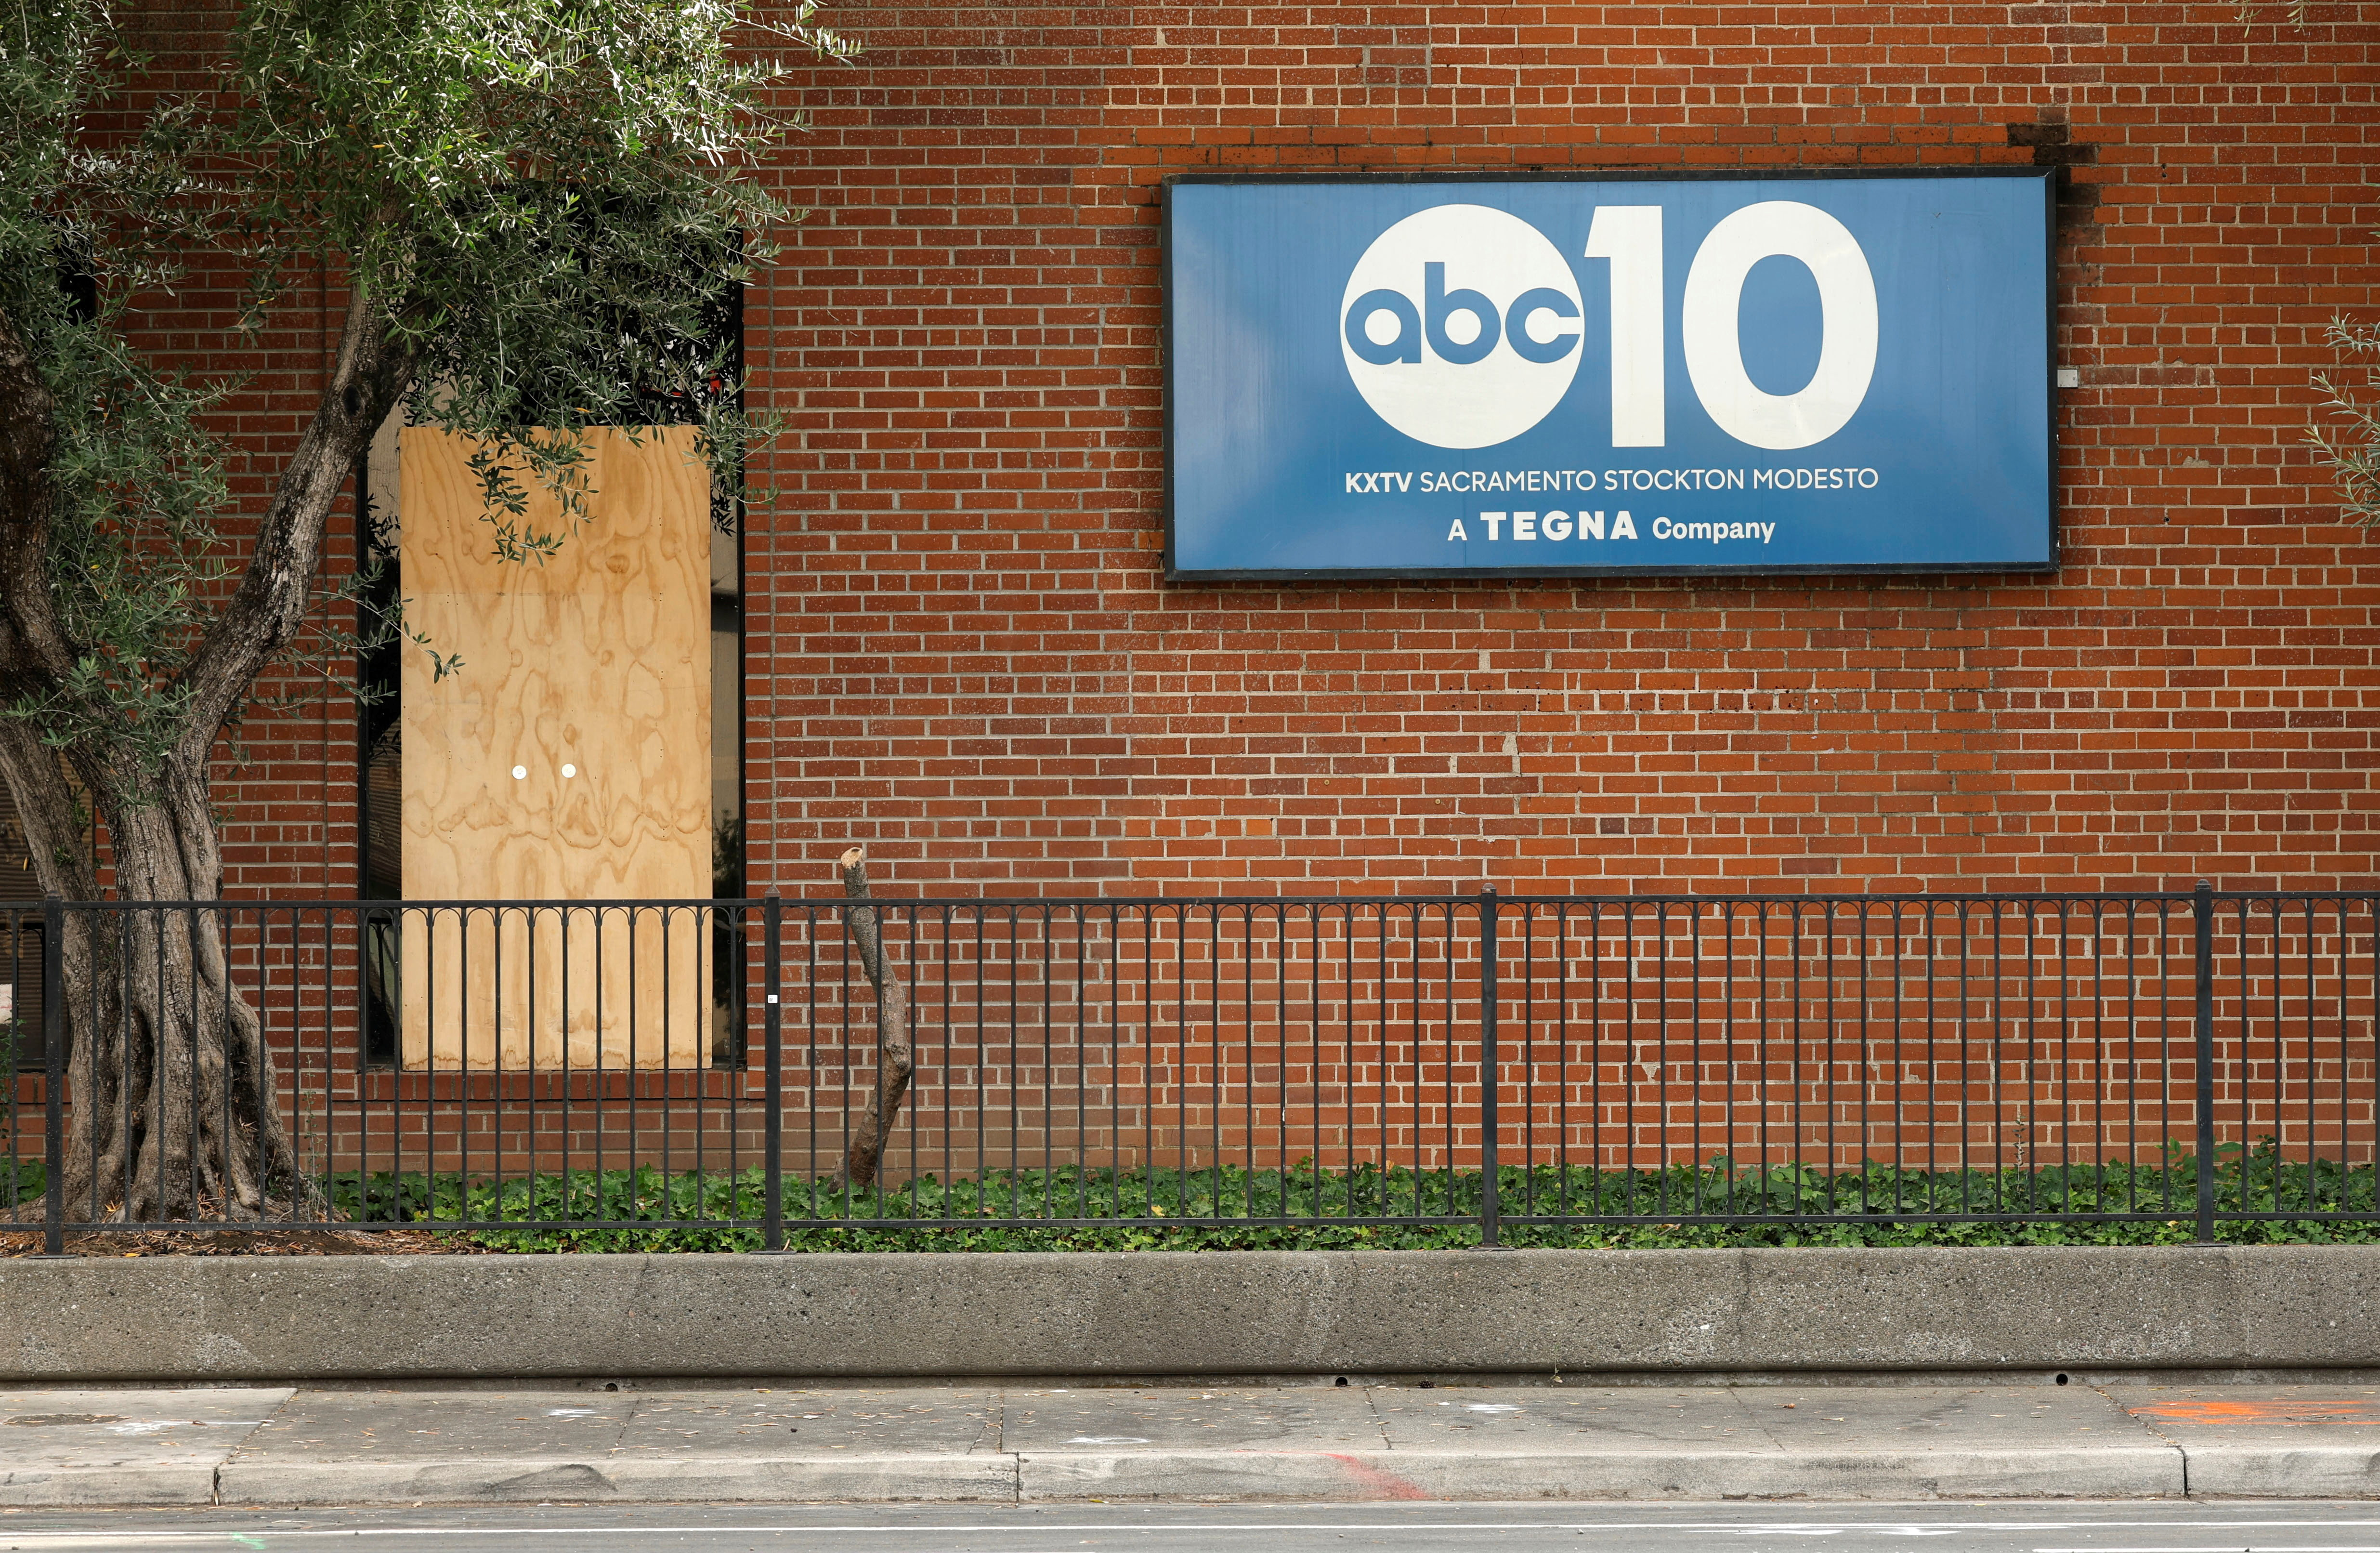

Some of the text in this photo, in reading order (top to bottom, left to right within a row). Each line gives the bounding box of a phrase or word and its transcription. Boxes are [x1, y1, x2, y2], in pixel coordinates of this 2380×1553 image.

[1345, 200, 1879, 450] abc 10
[1346, 468, 1879, 493] KXTV SACRAMENTO STOCKTON MODESTO
[1447, 510, 1776, 544] A TEGNA Company
